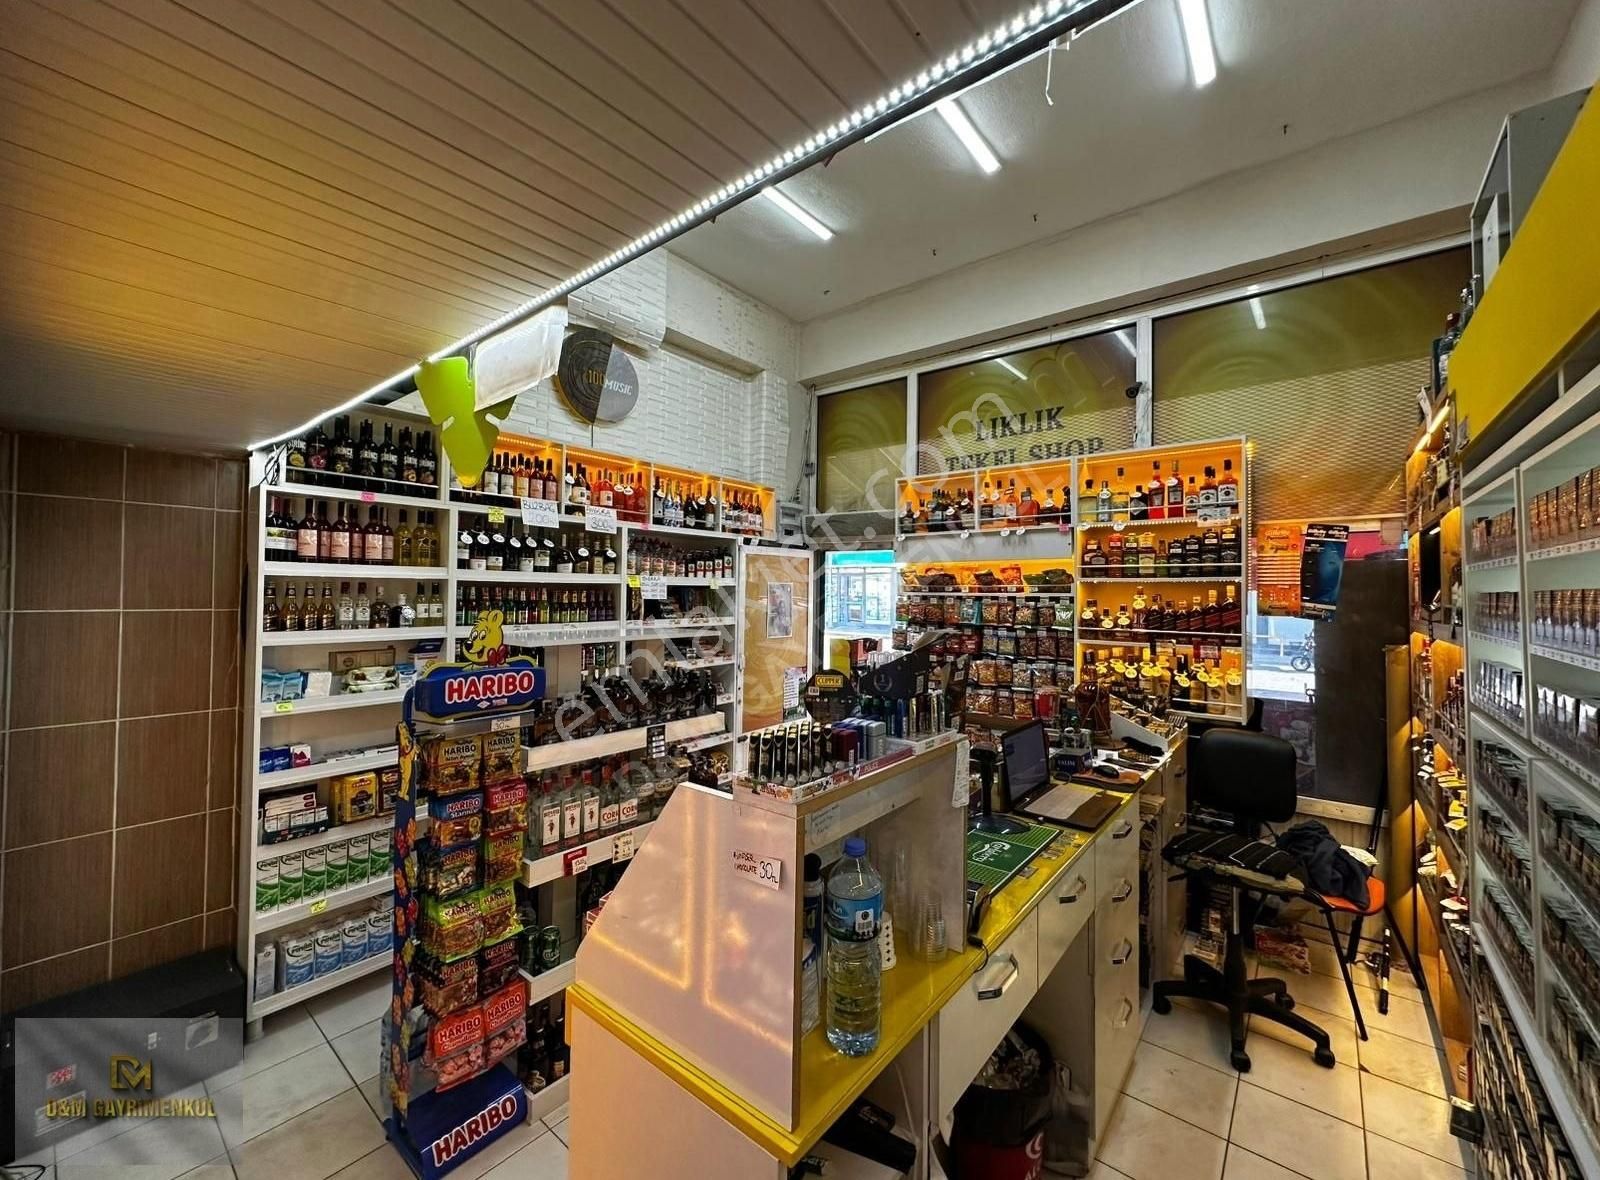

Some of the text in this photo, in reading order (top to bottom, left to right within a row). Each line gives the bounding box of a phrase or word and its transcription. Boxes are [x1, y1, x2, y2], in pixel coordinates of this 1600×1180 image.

[604, 379, 633, 396] MUSIC
[445, 670, 535, 705] HARIBO
[817, 675, 841, 686] CLIPPER
[443, 744, 477, 756] HARIBO
[487, 736, 516, 748] HARIBO
[493, 788, 524, 804] HARIBO
[446, 797, 481, 813] HARIBO
[442, 959, 476, 977] HARIBO
[486, 992, 523, 1020] HARIBO
[438, 1015, 482, 1043] HARIBO
[432, 1094, 518, 1168] HARIBO
